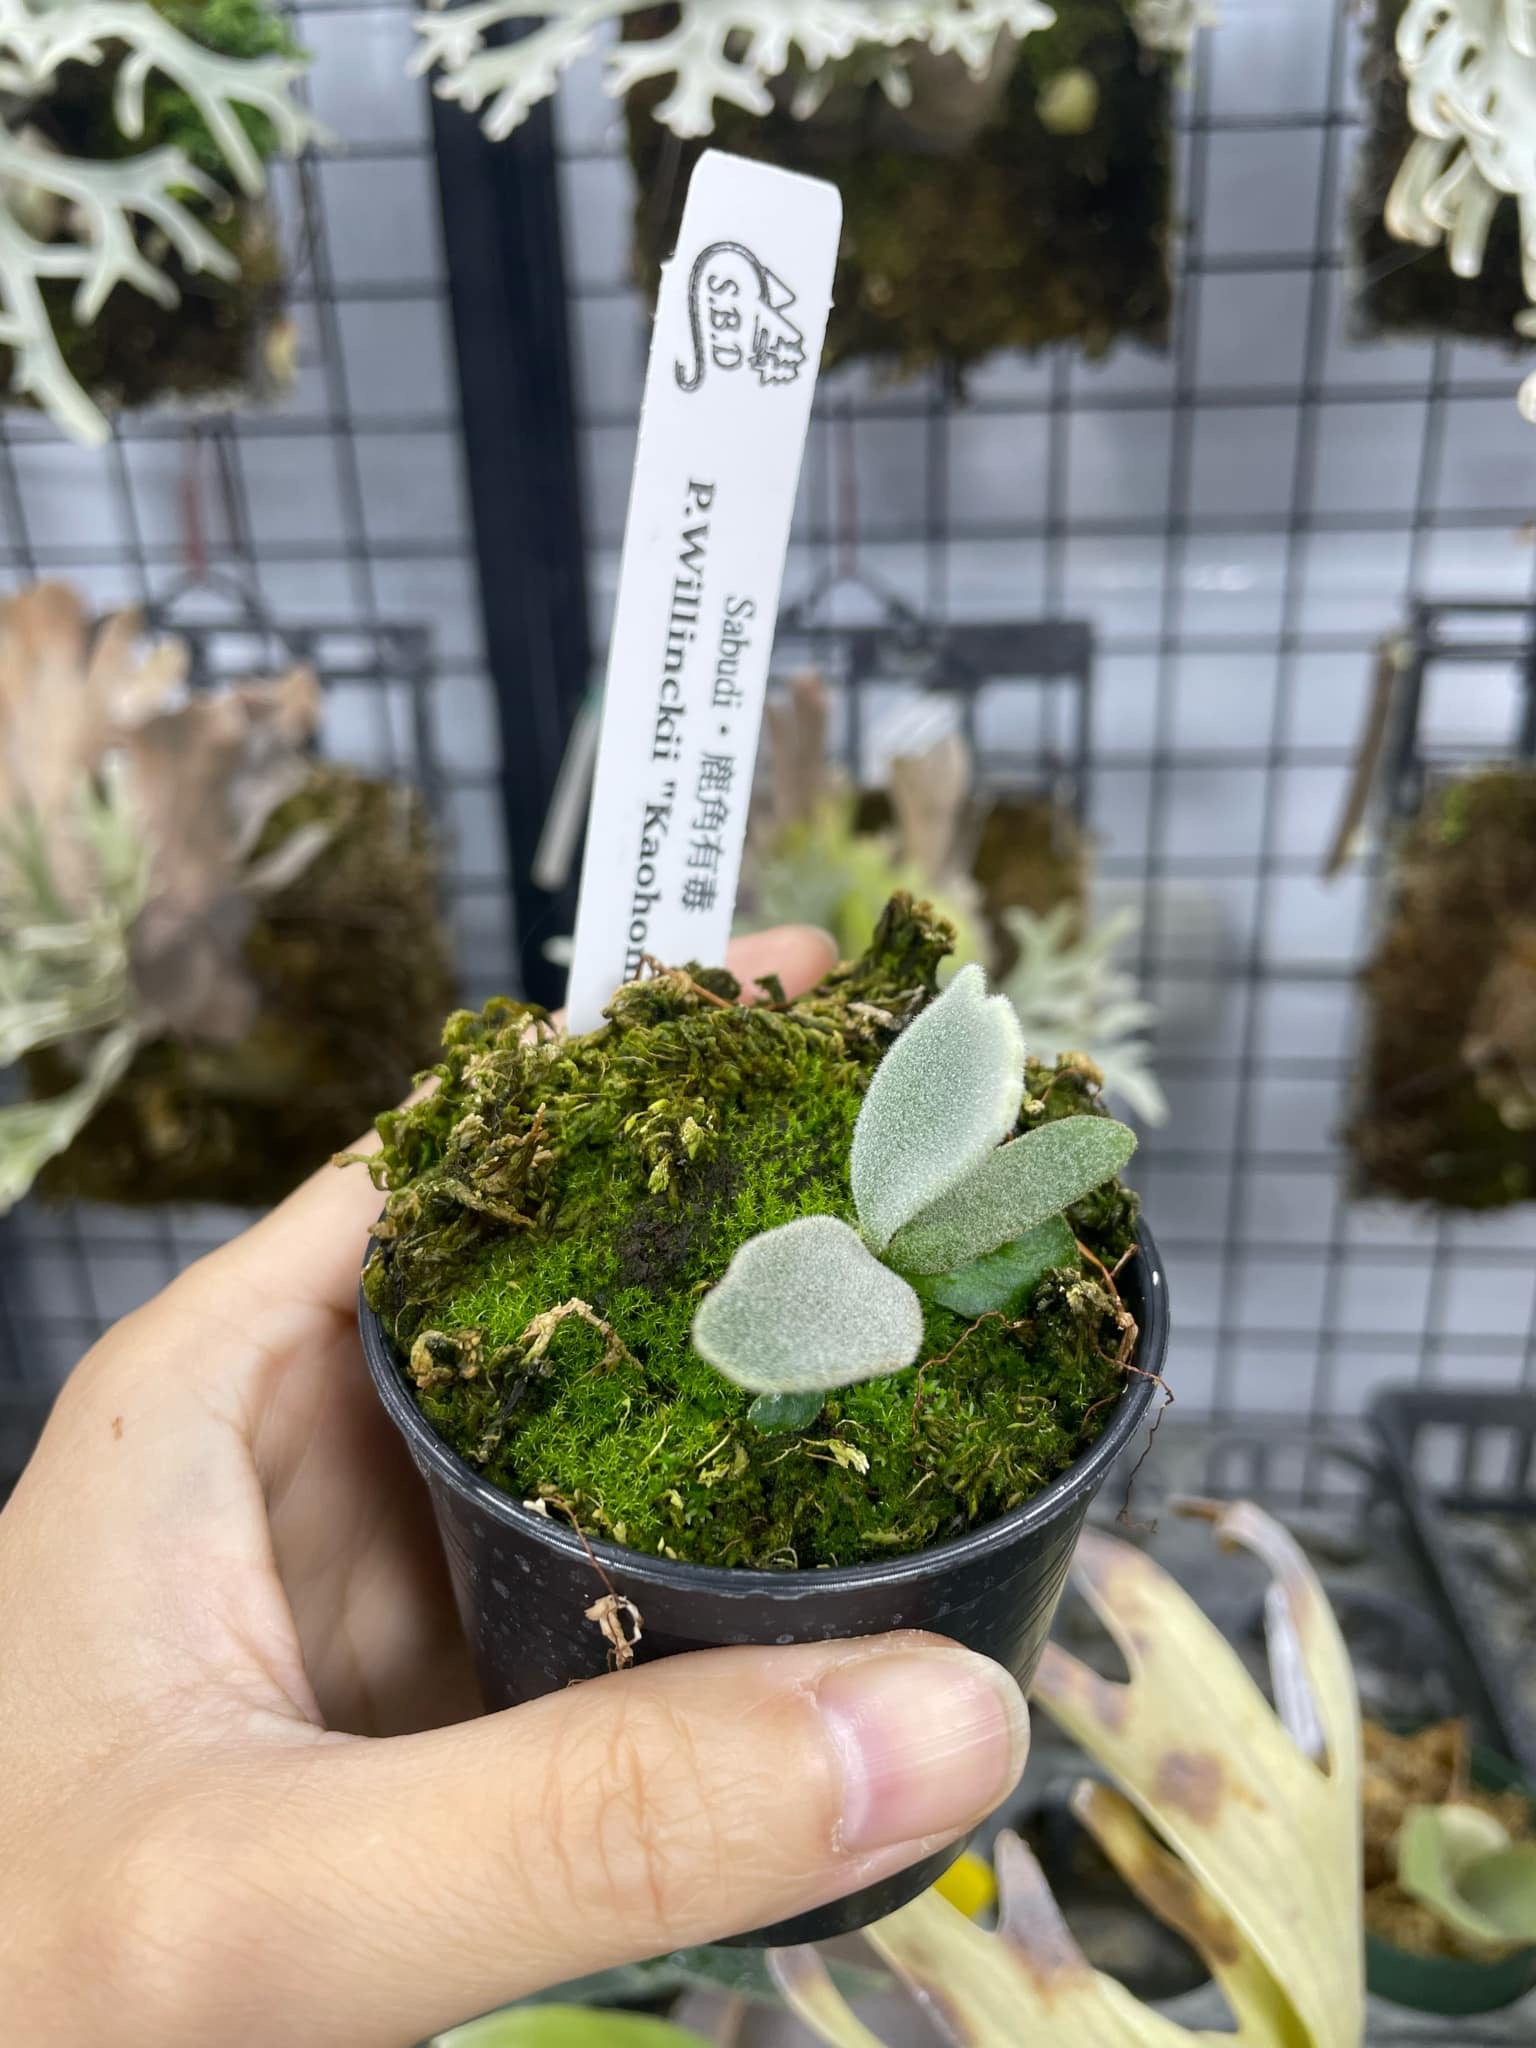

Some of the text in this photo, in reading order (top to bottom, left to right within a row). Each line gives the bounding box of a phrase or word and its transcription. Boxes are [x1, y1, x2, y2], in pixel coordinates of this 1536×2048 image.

[706, 275, 742, 367] S.B.D
[652, 478, 714, 761] P.Willinckii
[712, 597, 754, 707] Sabudi
[681, 752, 736, 912] 鹿角有毒
